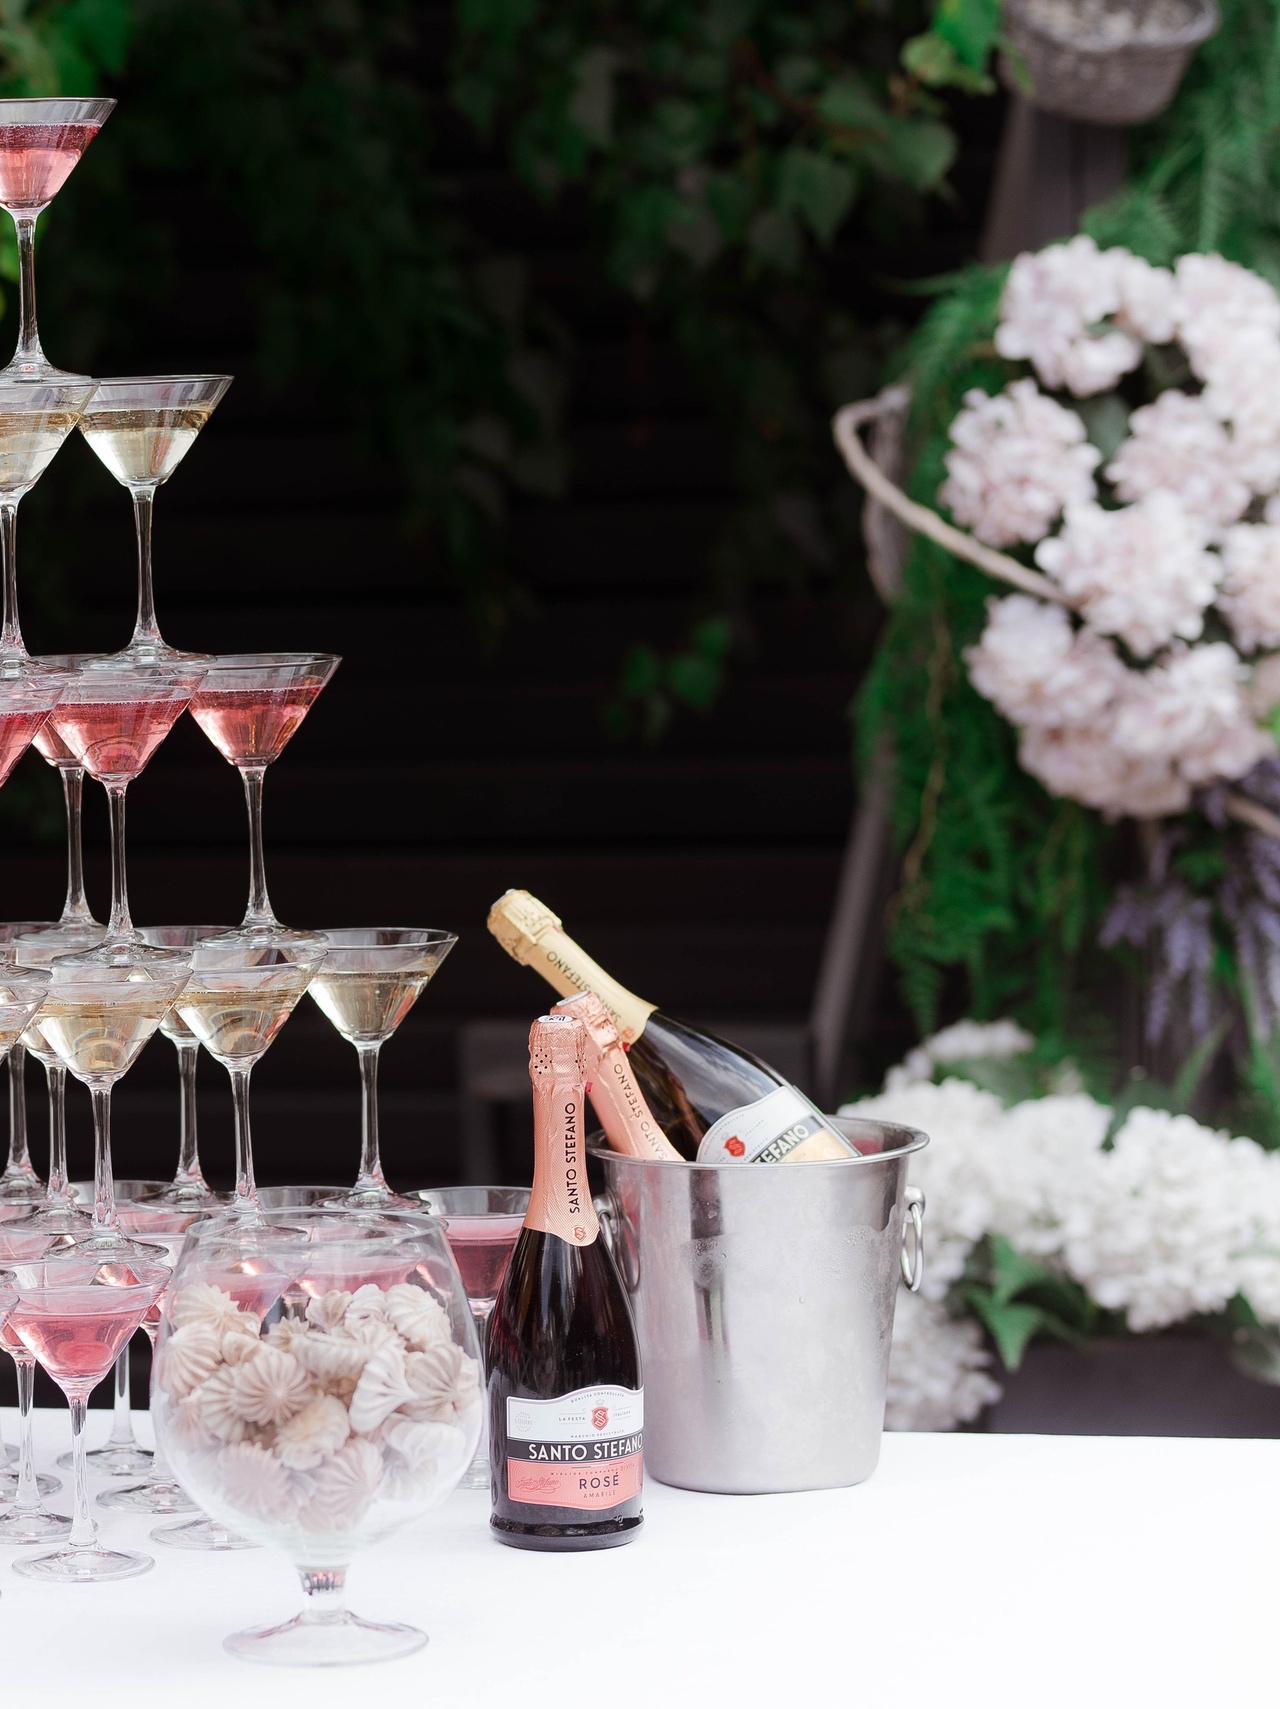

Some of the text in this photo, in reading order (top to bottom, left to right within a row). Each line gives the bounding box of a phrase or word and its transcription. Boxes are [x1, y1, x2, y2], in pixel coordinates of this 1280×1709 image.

[613, 1063, 668, 1160] SANTO STEFANO
[564, 1102, 580, 1214] SANTO STEFANO
[528, 1433, 643, 1461] SANTO STEFANO
[579, 1471, 620, 1490] ROSÉ
[583, 1490, 616, 1499] AMABILE
